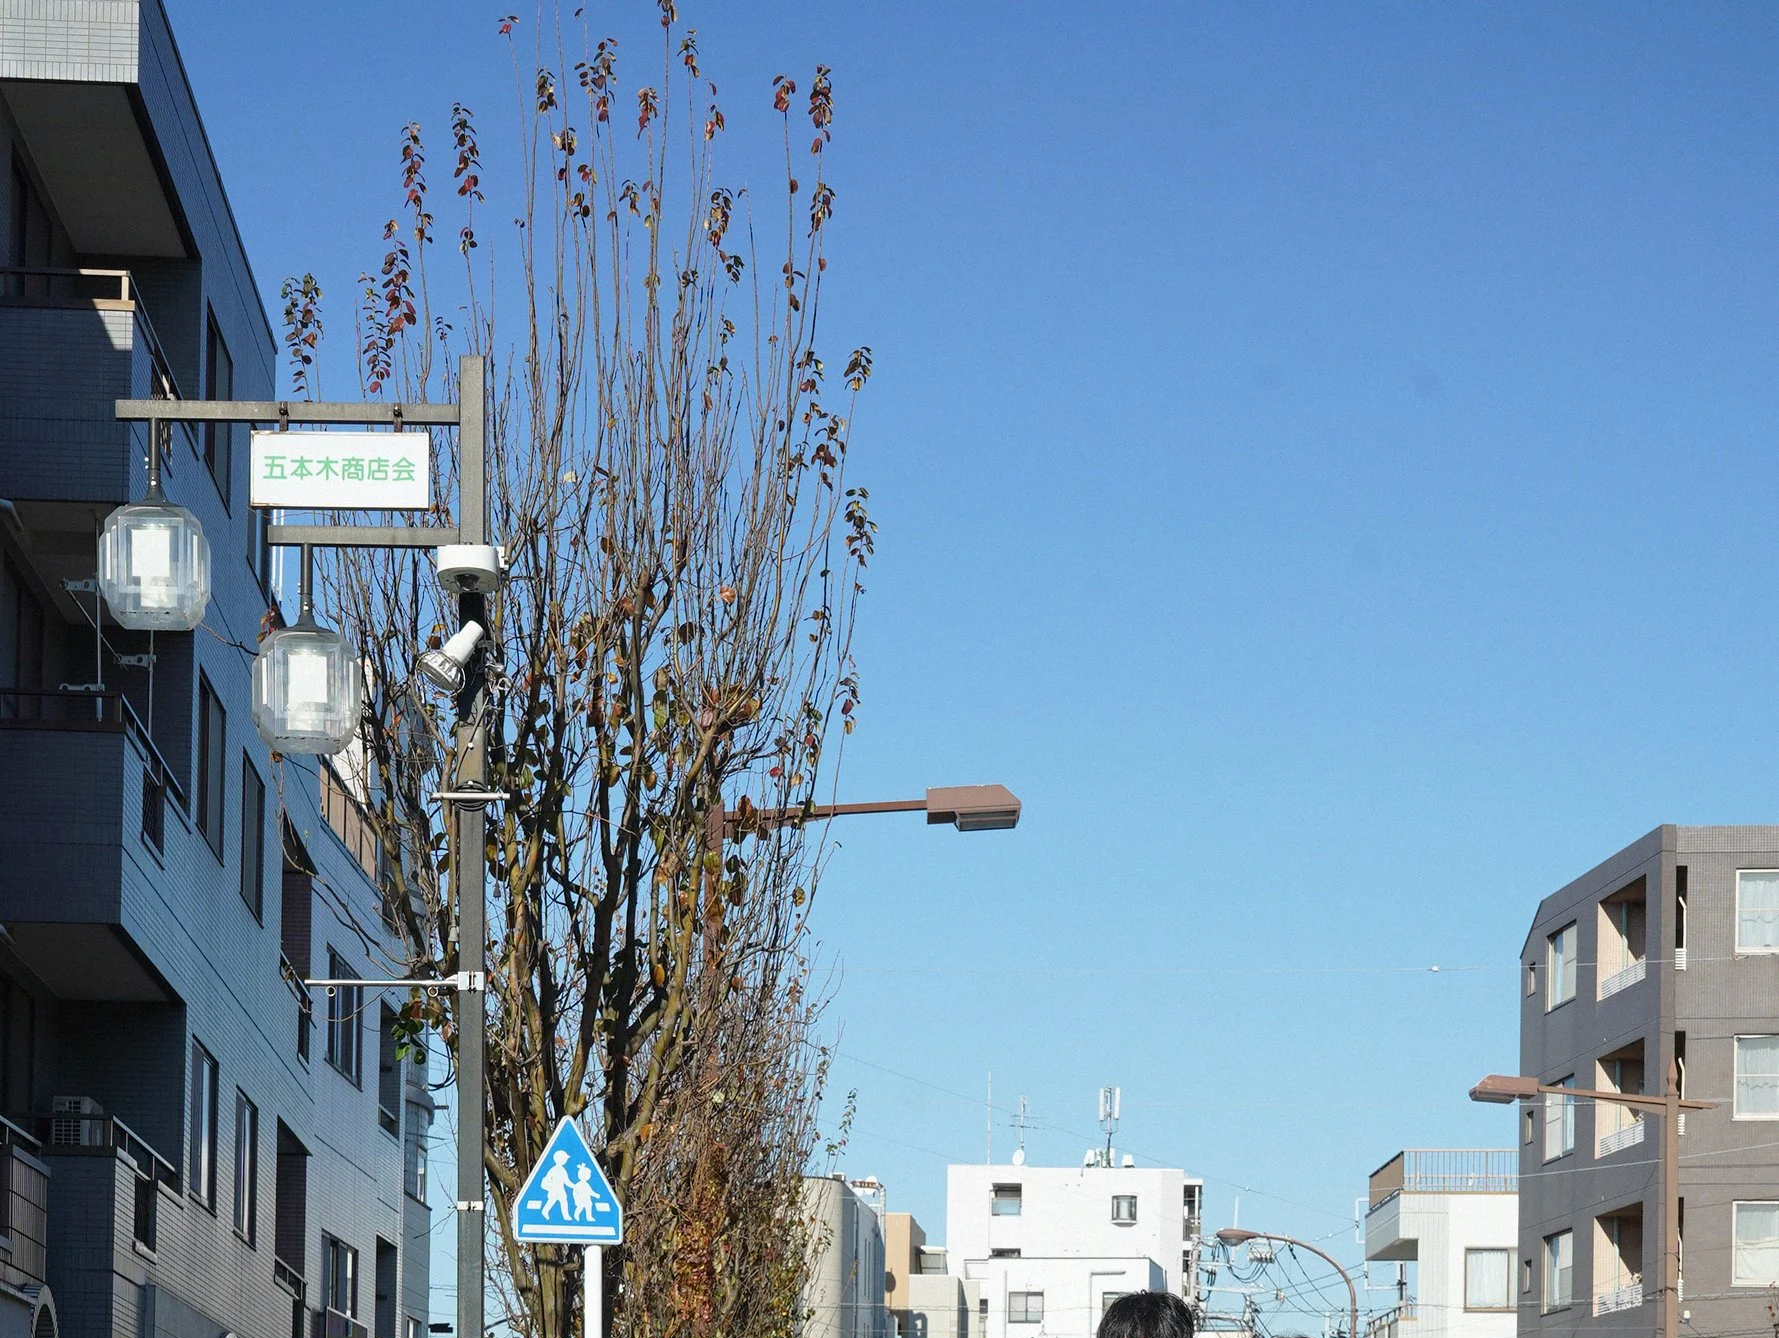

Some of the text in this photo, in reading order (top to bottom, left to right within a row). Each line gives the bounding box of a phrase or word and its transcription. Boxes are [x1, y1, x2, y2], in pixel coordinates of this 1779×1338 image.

[262, 455, 416, 482] 五本木商店会
